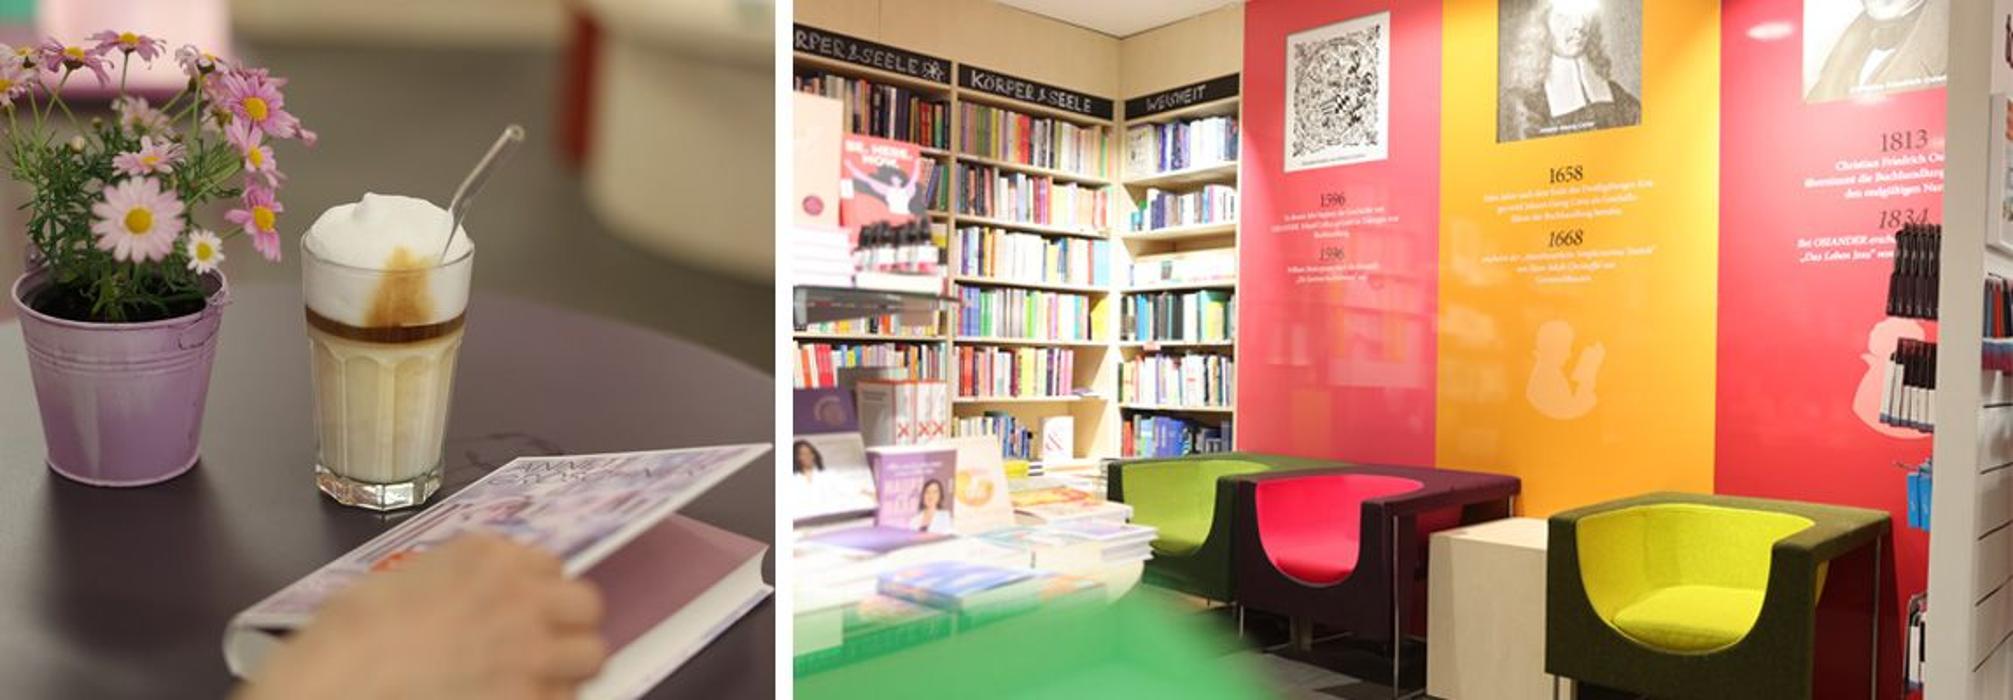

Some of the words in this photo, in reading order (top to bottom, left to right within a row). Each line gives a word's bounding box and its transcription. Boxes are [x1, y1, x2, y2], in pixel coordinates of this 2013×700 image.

[970, 70, 1035, 100] KÖRPER
[1050, 90, 1092, 113] SEELE
[1145, 84, 1206, 111] WEISHEIT
[1881, 129, 1929, 152] 1813
[1549, 165, 1584, 184] 1658
[1549, 229, 1584, 248] 1668
